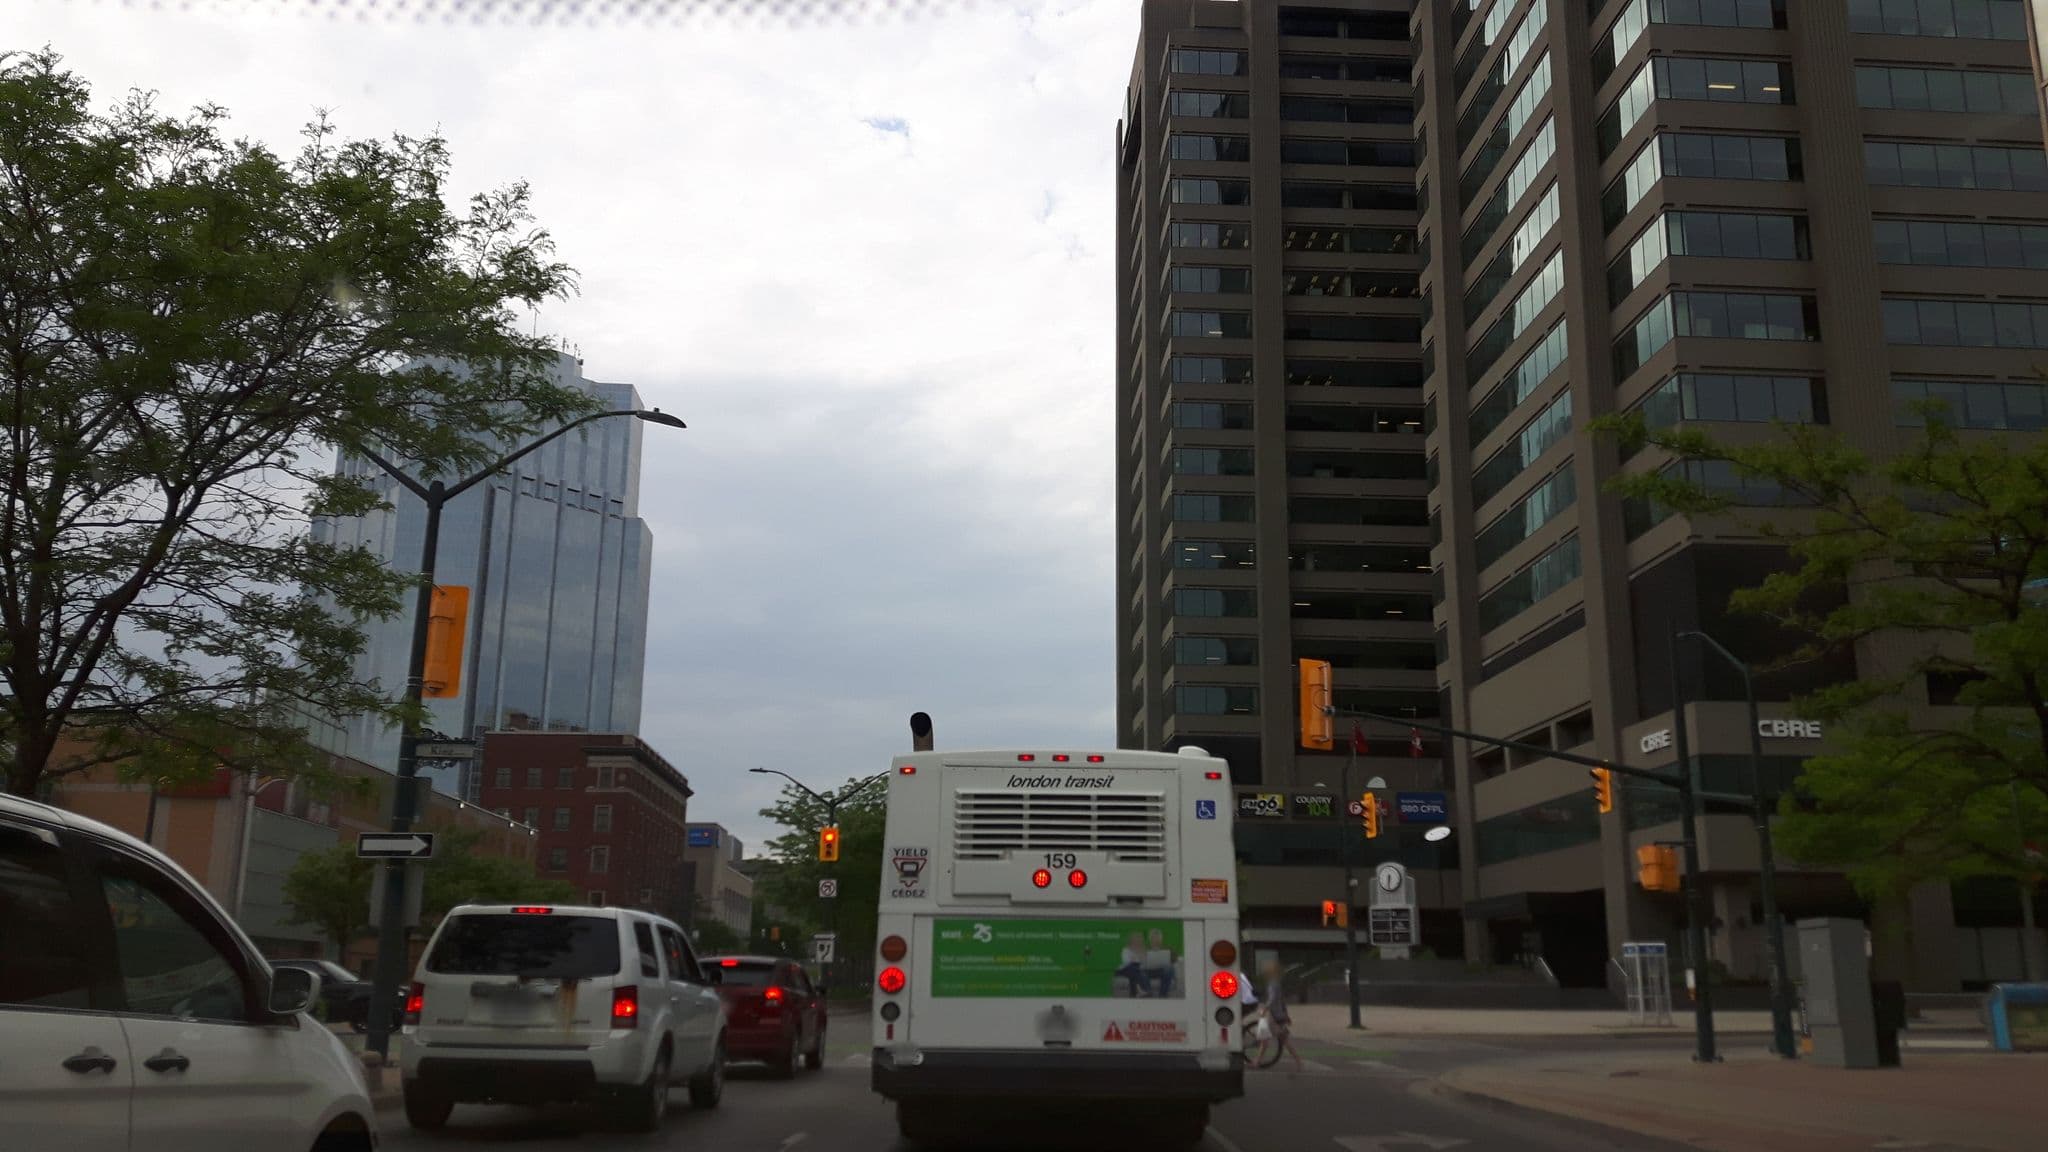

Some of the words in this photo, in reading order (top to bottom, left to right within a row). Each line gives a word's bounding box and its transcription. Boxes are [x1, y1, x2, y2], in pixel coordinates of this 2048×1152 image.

[1758, 720, 1822, 738] CBRE
[1640, 729, 1672, 753] CBRE
[1007, 774, 1061, 789] london
[1064, 774, 1115, 789] transit
[1295, 795, 1332, 804] COUNTRY
[893, 848, 928, 857] YIELD
[1044, 853, 1077, 869] 159
[972, 923, 993, 943] 25
[1129, 1021, 1176, 1031] CAUTION
